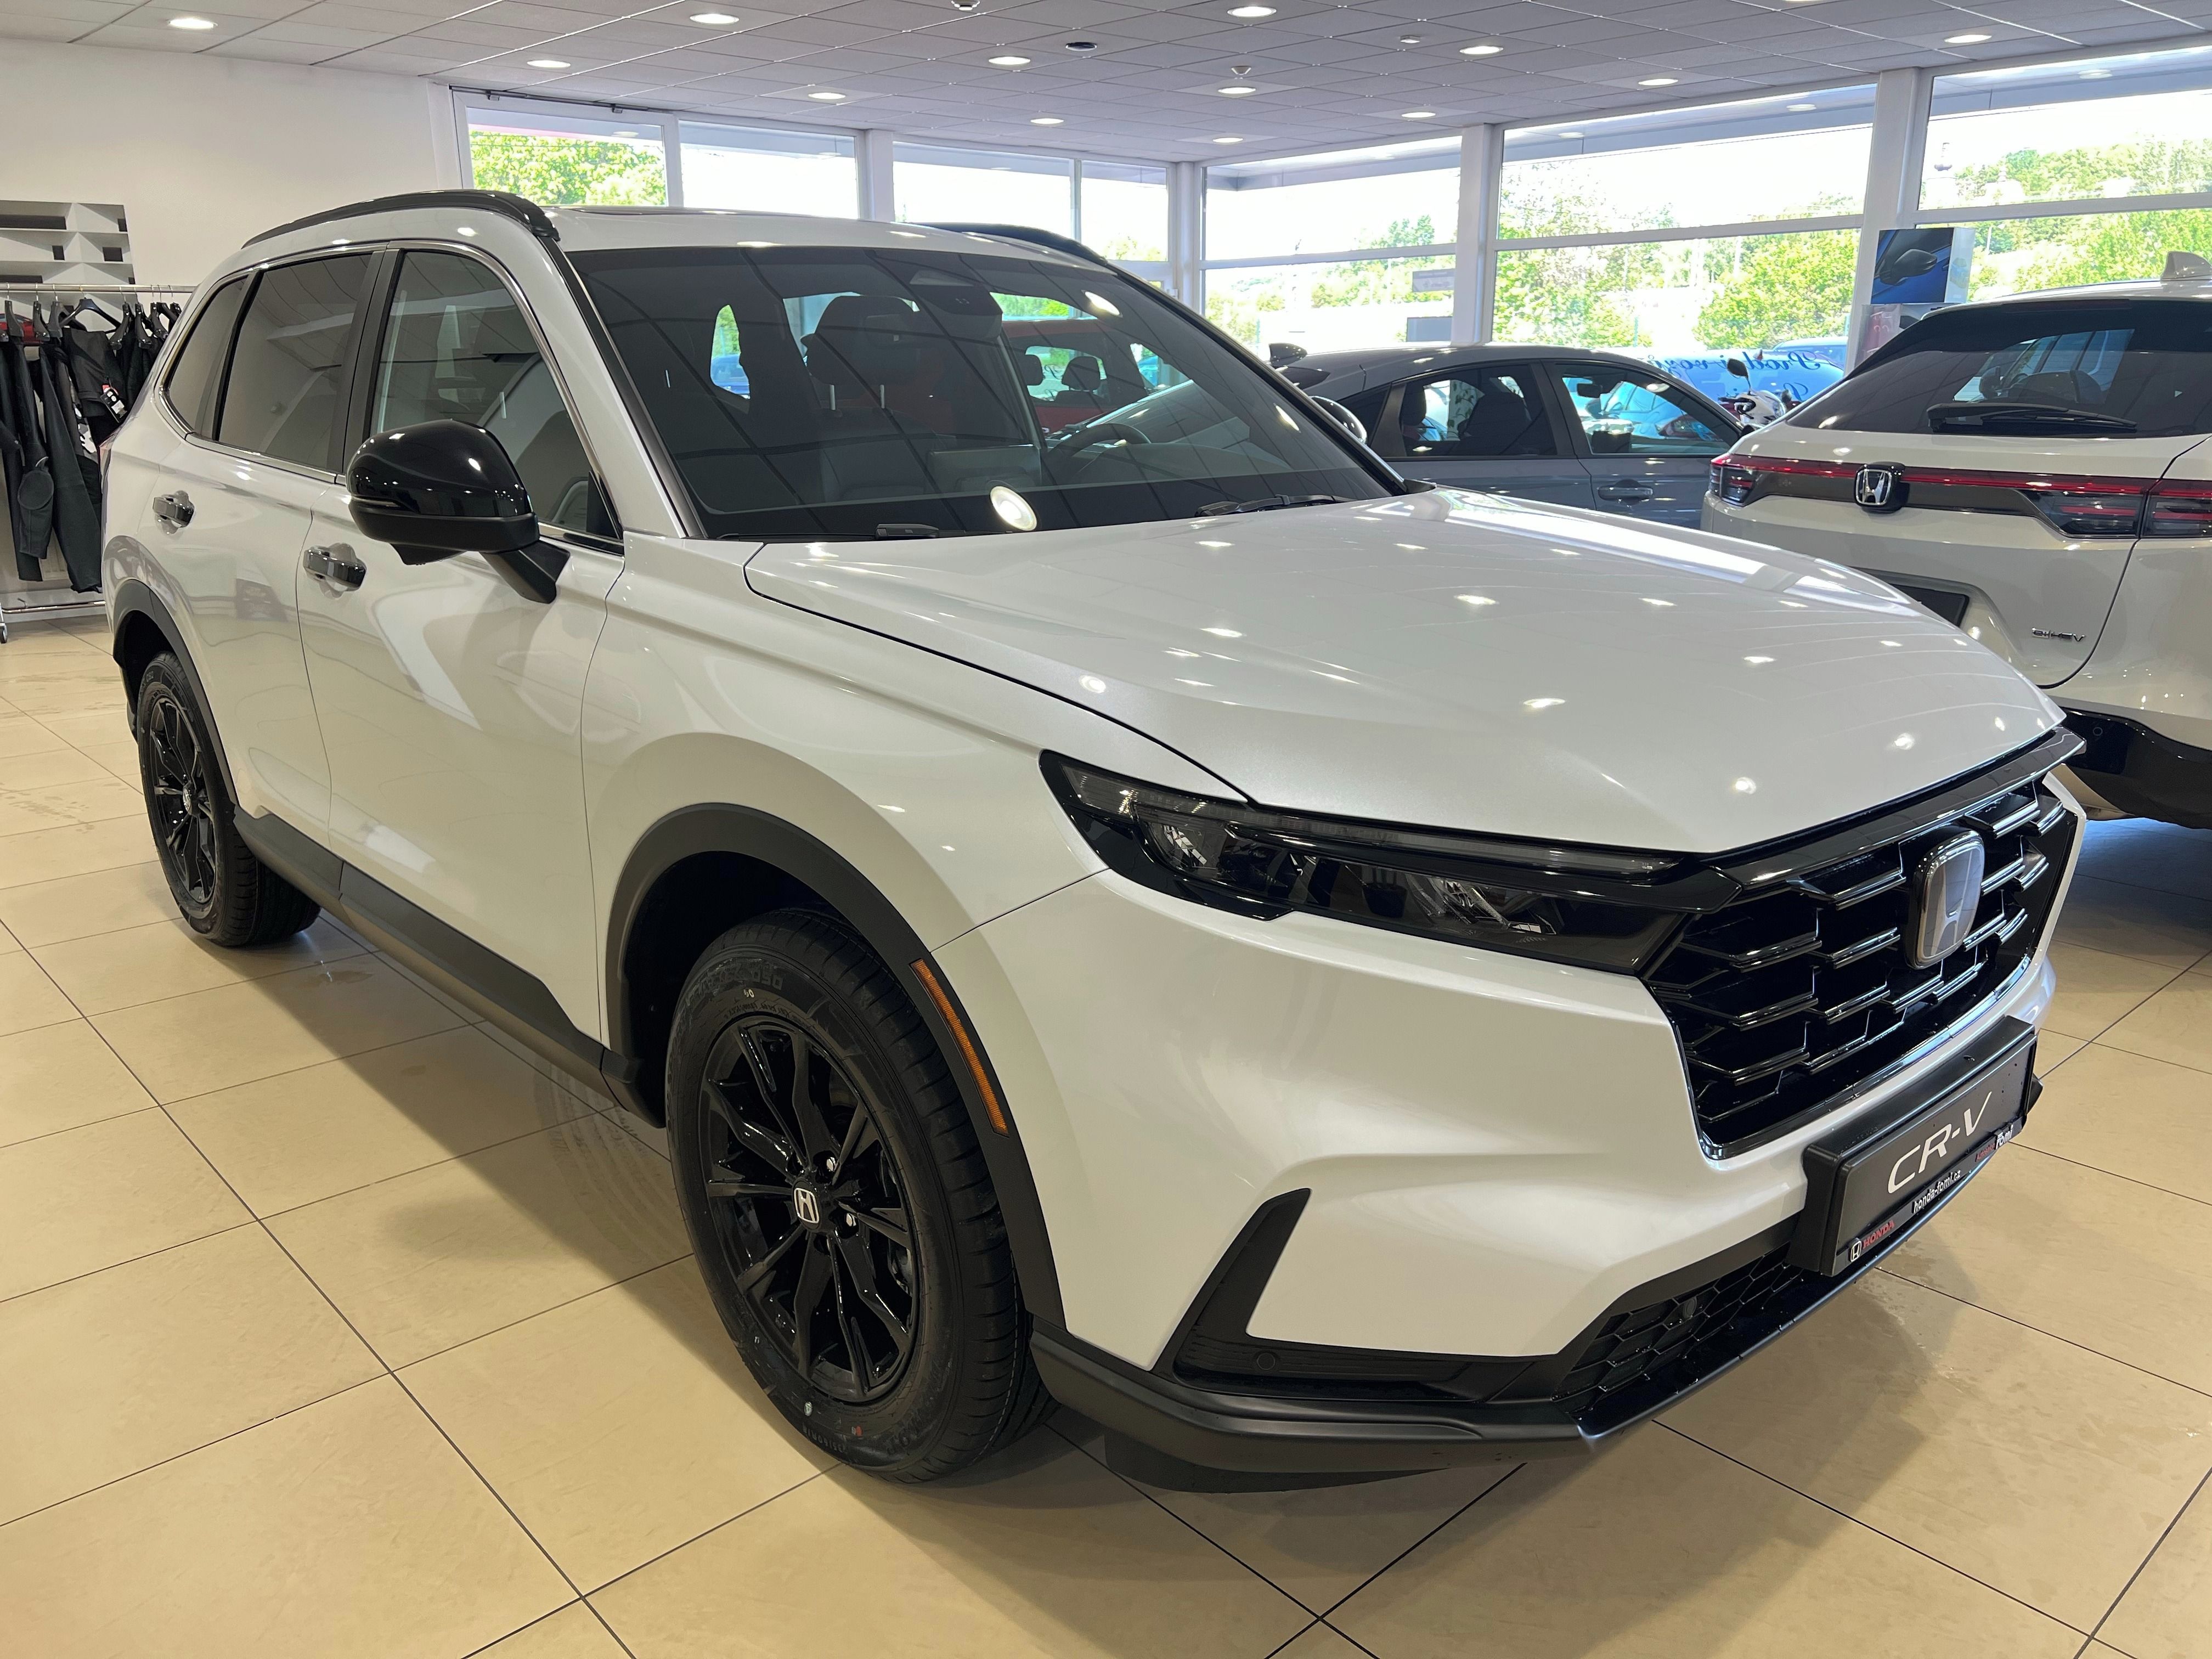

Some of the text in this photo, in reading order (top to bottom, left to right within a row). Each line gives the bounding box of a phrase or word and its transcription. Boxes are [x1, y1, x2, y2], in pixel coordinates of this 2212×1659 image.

[1887, 1091, 1993, 1194] CR-V
[1995, 1124, 2014, 1150] Fomi
[1912, 1170, 1961, 1214] honda-fomi.cz
[1862, 1220, 1895, 1249] HONDA
